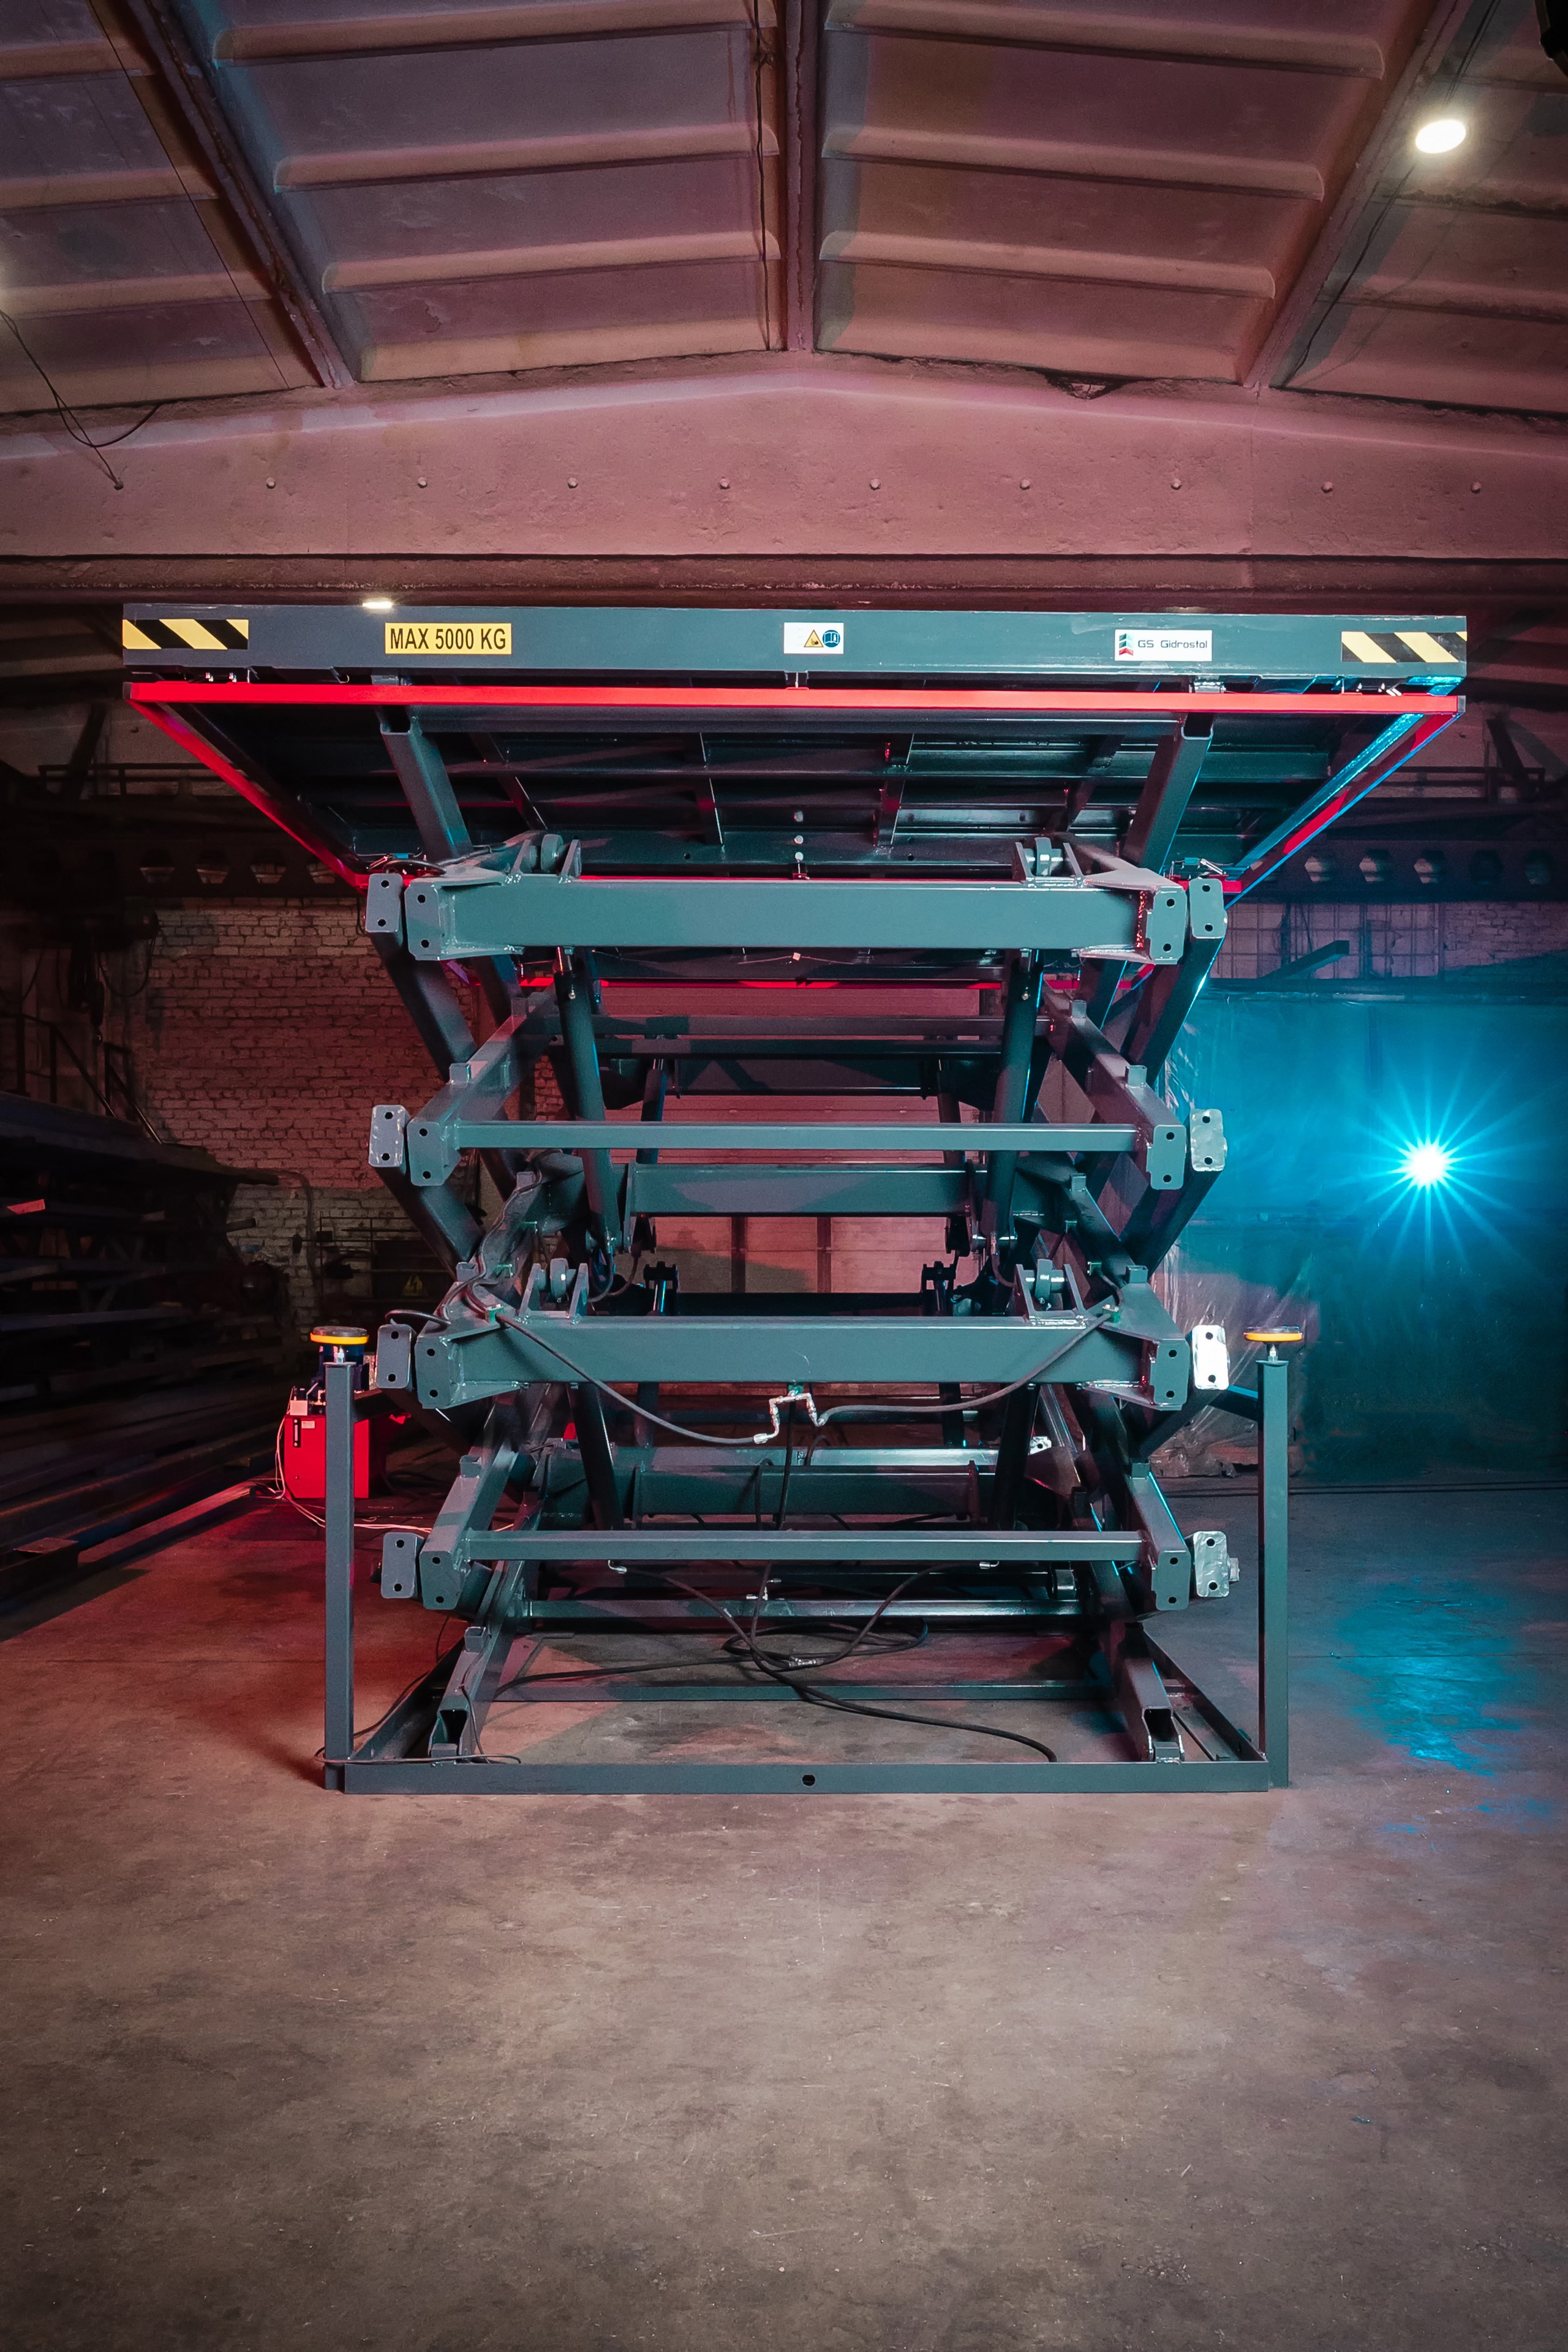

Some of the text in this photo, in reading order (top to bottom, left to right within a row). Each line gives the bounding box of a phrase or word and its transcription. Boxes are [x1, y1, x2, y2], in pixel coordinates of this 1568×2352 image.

[390, 628, 506, 650] MAX 5000 KG
[1137, 639, 1208, 649] GS Gidrostol
